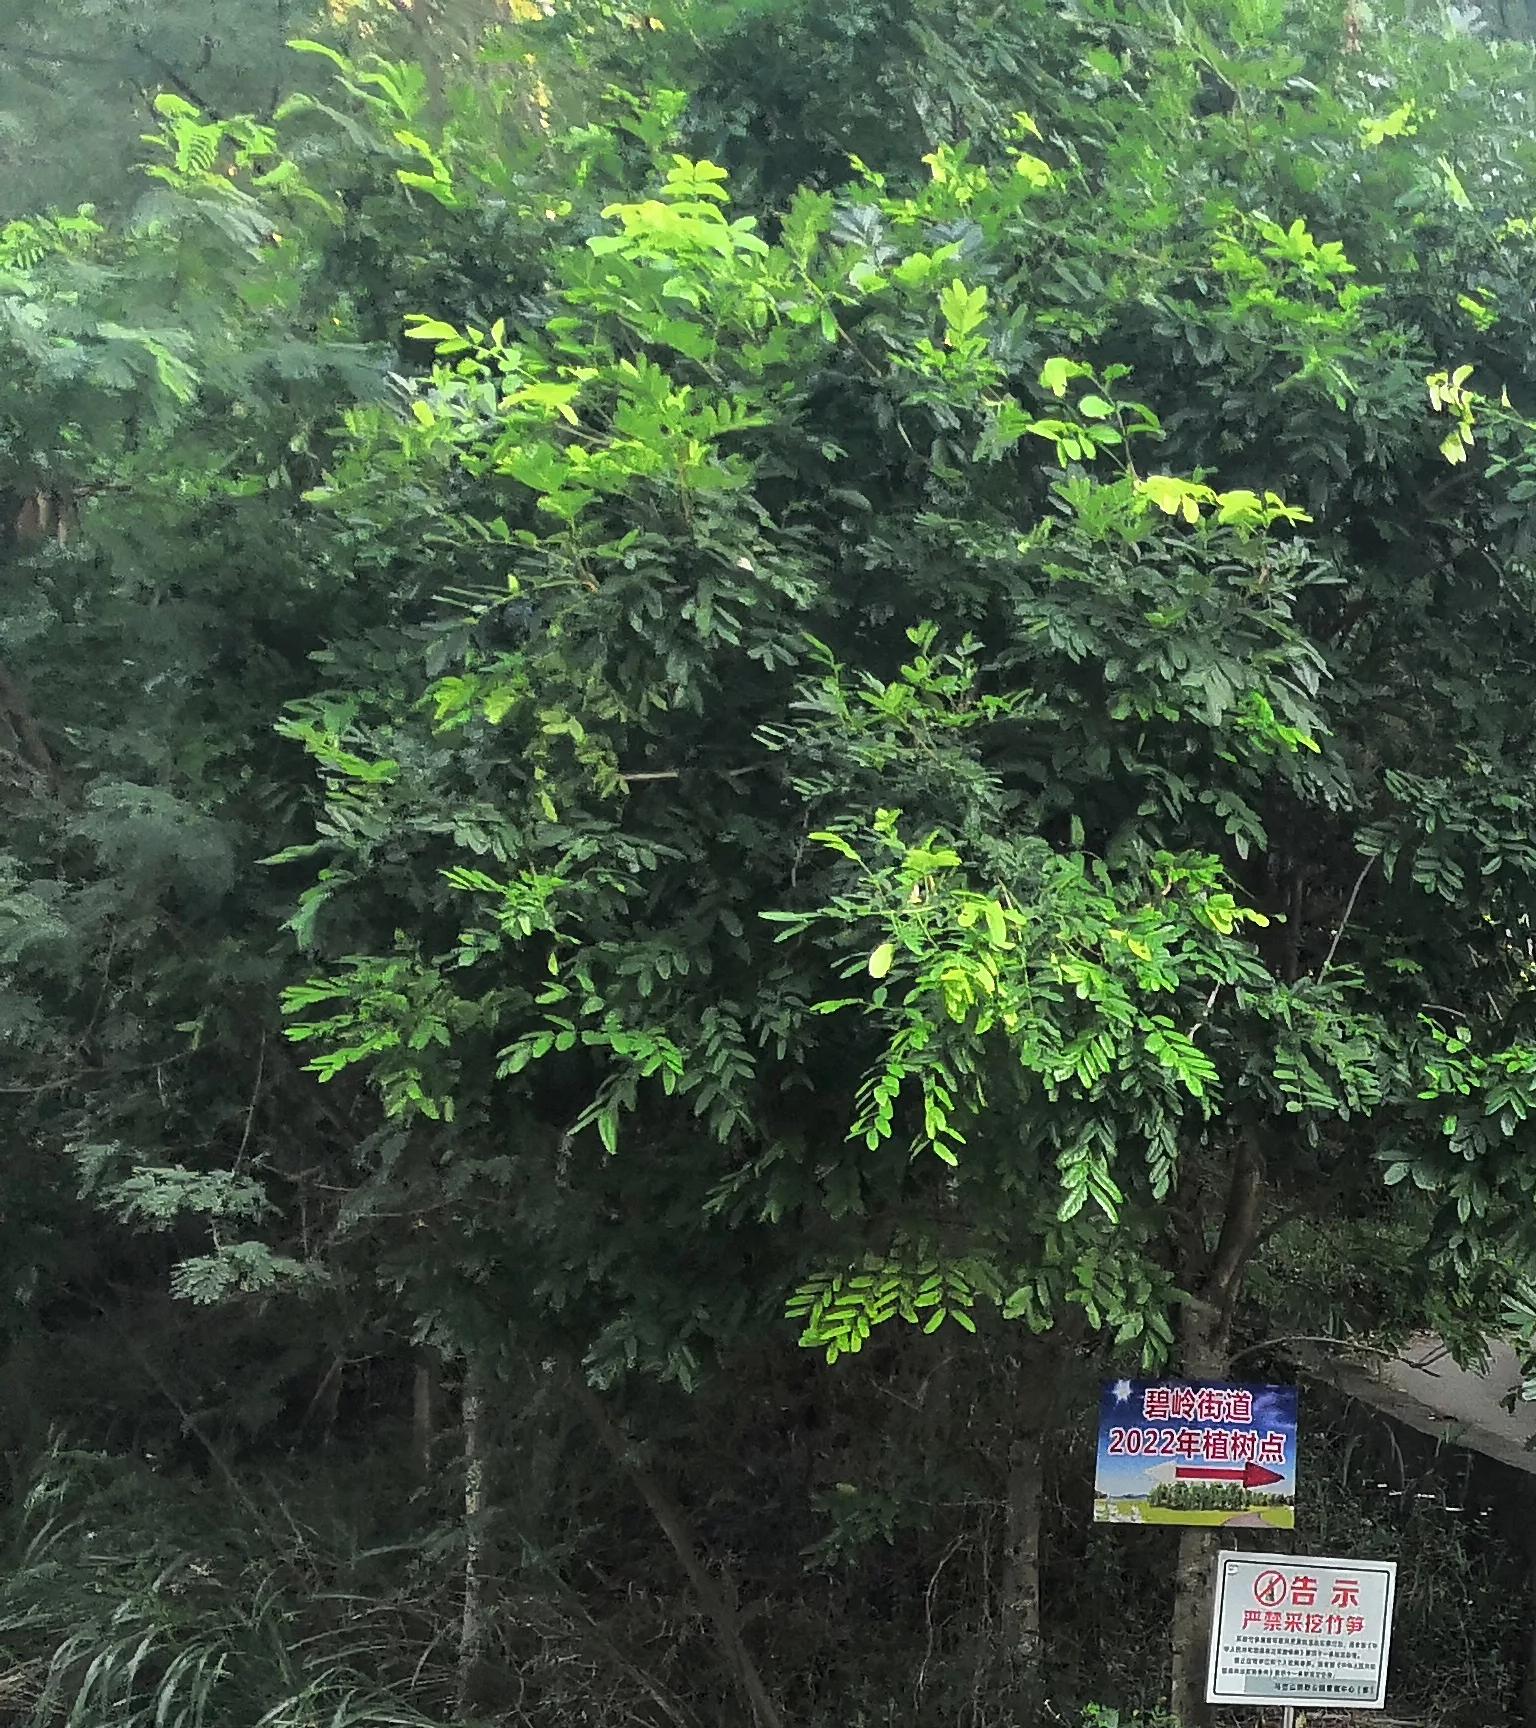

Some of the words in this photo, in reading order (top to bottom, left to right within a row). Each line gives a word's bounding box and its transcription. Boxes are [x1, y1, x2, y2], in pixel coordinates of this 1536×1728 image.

[1143, 1387, 1252, 1423] 碧岭街道
[1109, 1428, 1286, 1464] 2022年植树点
[1242, 1610, 1365, 1636] 严禁采挖竹笋
